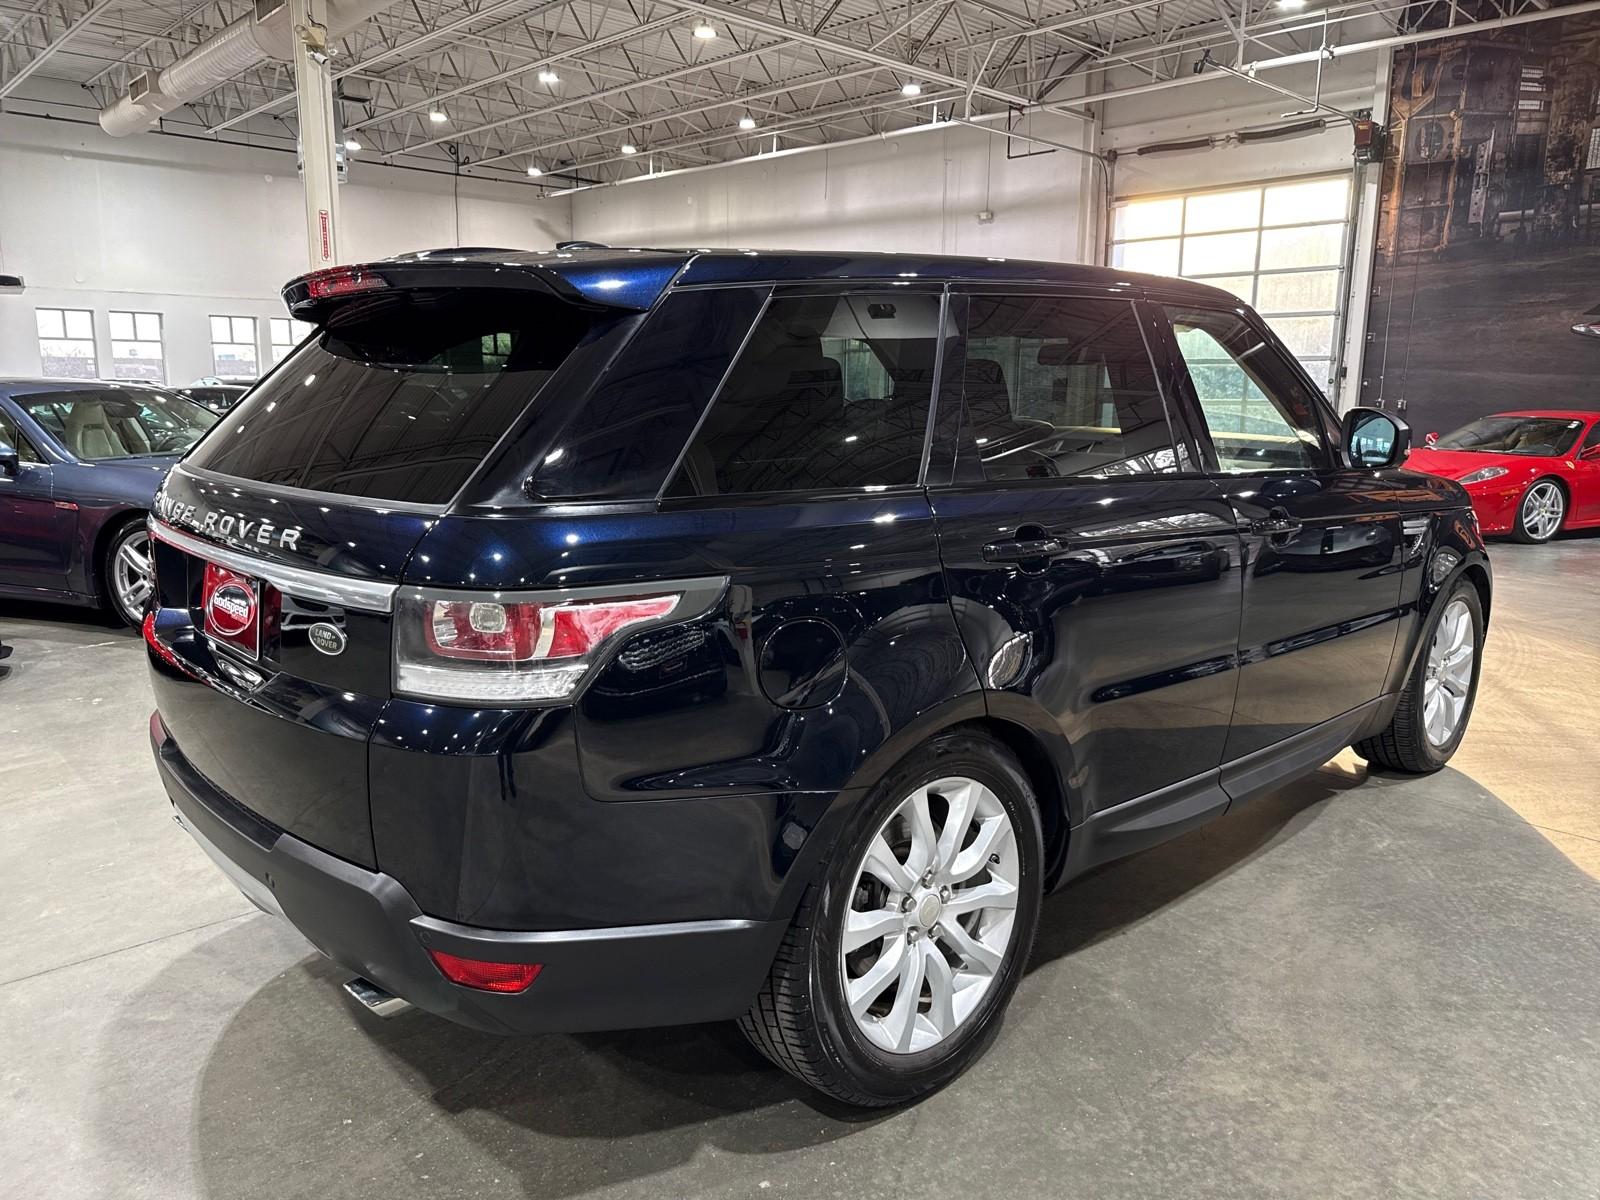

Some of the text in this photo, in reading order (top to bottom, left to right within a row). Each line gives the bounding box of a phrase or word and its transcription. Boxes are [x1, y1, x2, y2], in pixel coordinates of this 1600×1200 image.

[204, 512, 300, 551] ROVER
[213, 592, 249, 618] Godspeed
[315, 628, 332, 640] LAND
[317, 637, 337, 649] ROVER
